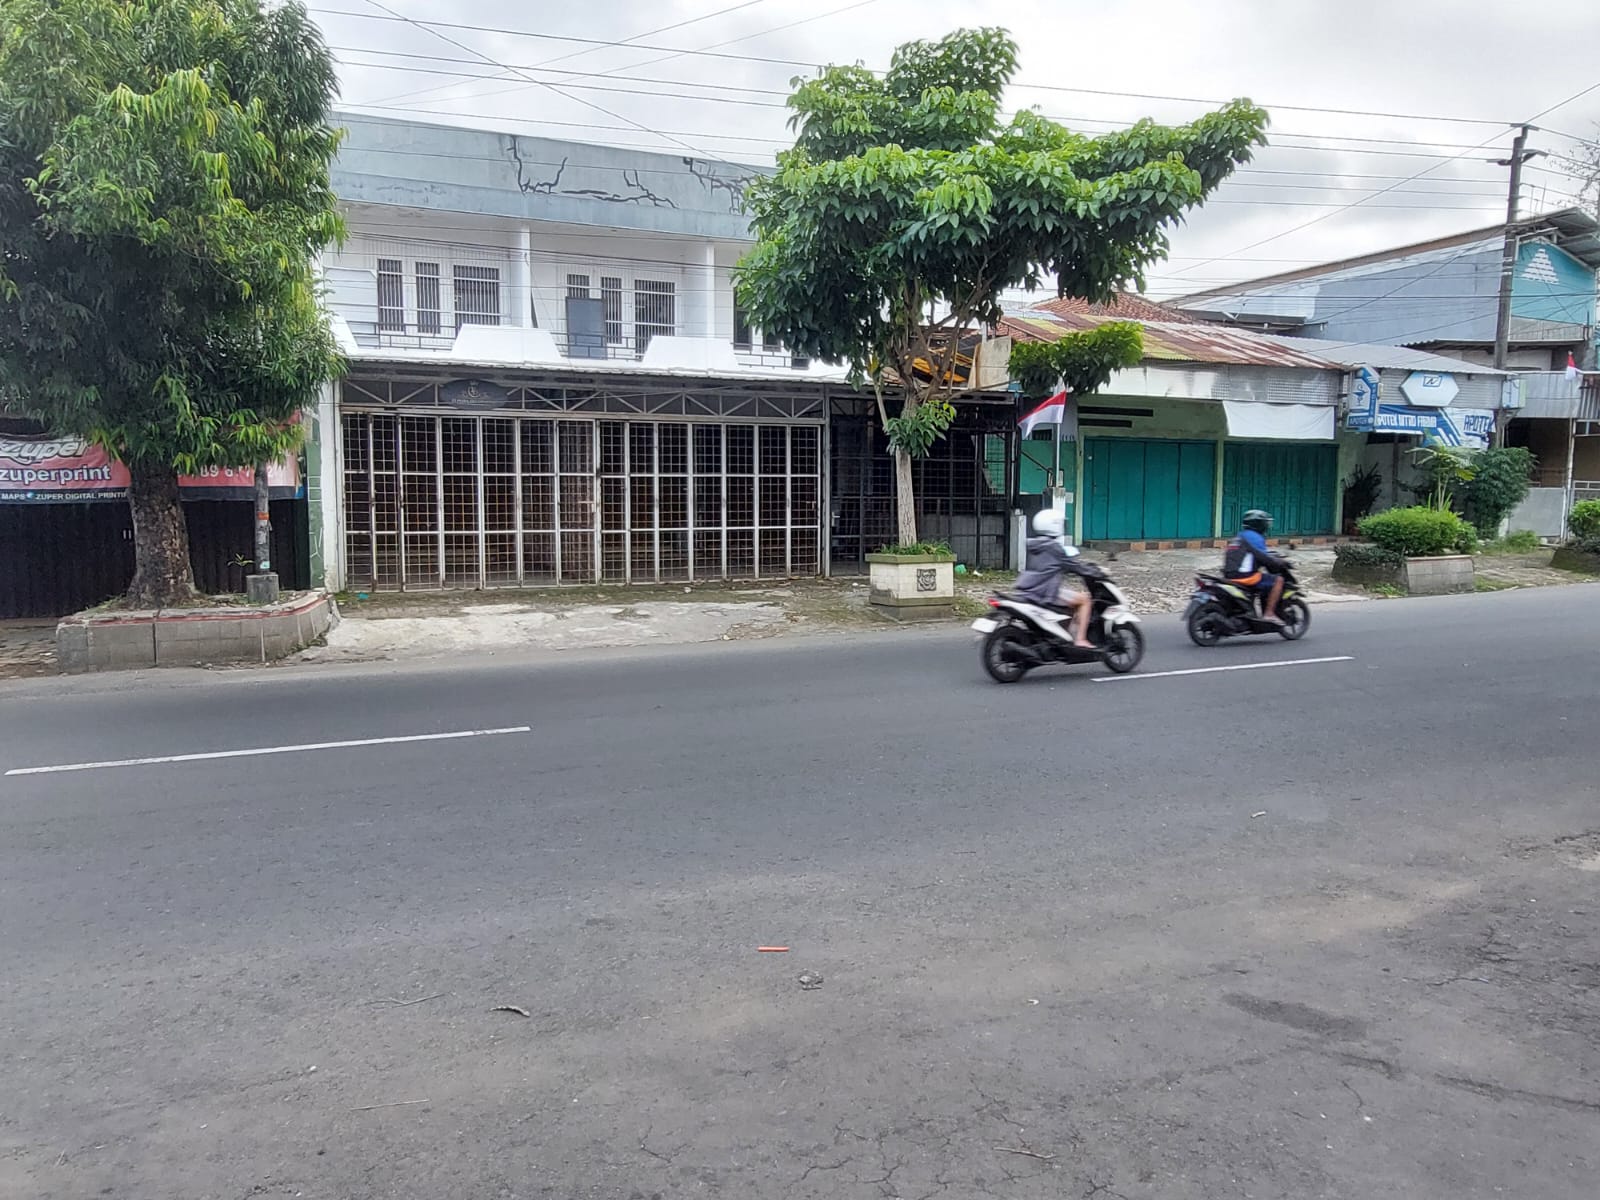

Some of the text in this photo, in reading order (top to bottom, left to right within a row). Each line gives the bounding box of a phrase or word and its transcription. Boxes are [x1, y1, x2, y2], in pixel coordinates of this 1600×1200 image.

[1463, 414, 1495, 433] APOTEK
[0, 464, 111, 485] zuperprint
[65, 492, 97, 500] DIGITAL
